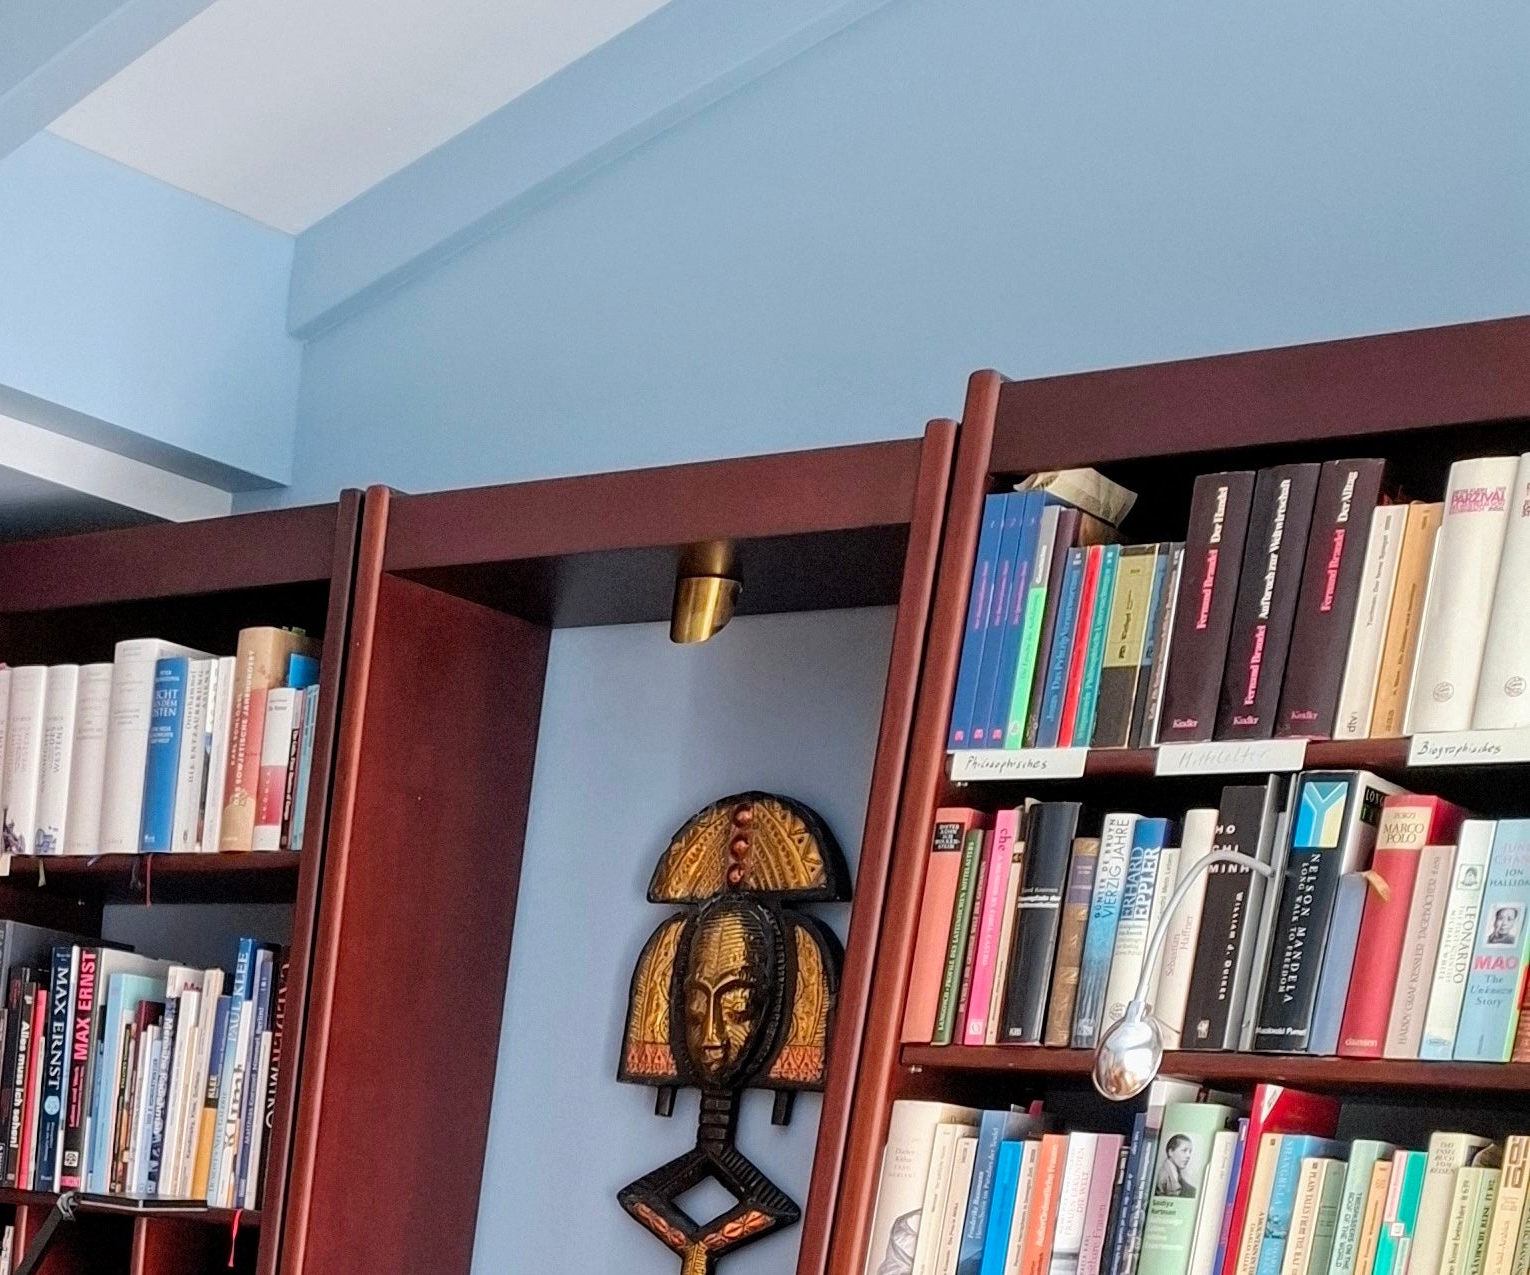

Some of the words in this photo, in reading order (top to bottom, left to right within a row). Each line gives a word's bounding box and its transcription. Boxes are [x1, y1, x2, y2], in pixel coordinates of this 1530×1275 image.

[1213, 486, 1228, 523] Handel
[1337, 502, 1350, 523] Der
[1210, 524, 1223, 544] Der
[1417, 741, 1502, 755] Biographisches
[1215, 824, 1236, 834] HO
[1383, 823, 1425, 834] MARCO
[1386, 833, 1417, 844] POLO
[1101, 866, 1122, 918] VIERZIG
[1114, 819, 1130, 863] JAHRE
[1122, 846, 1144, 921] ERHARD
[1134, 846, 1160, 921] EPPLER
[1209, 864, 1249, 874] MINH
[1302, 853, 1321, 916] NELSON
[1453, 905, 1477, 984] LEONARDO
[1283, 926, 1306, 1003] MANDELA
[1473, 956, 1520, 970] MAO
[52, 967, 70, 1016] MAX
[78, 950, 97, 1011] ERNST
[1470, 986, 1513, 995] Unknown
[1485, 975, 1503, 983] The
[227, 1000, 241, 1042] PAUL
[234, 951, 248, 998] KLEE
[1475, 997, 1503, 1006] Story
[20, 1020, 30, 1048] Alles
[73, 1016, 91, 1062] MAX
[18, 1051, 28, 1083] muss
[48, 1021, 65, 1091] ERNST
[207, 1077, 217, 1099] KLEE
